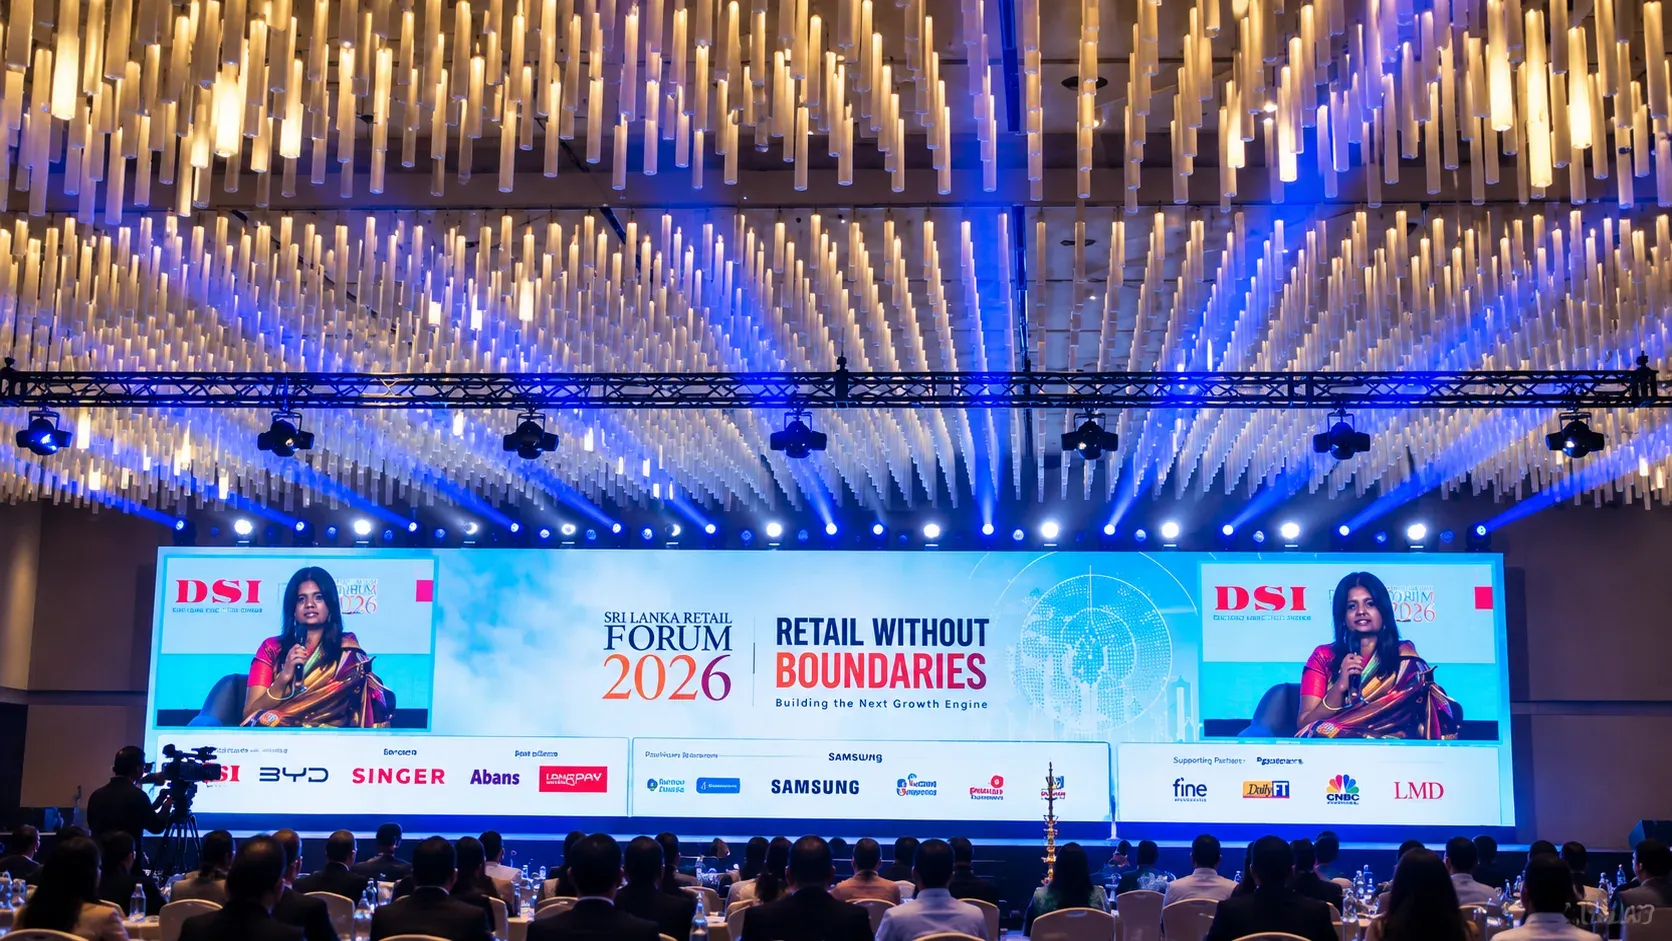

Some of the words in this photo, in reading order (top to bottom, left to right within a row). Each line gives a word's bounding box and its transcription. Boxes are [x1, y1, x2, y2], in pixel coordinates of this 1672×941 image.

[175, 579, 263, 604] DSI
[1214, 586, 1308, 611] DSI
[603, 611, 627, 624] SRI
[629, 611, 682, 624] LANKA
[683, 612, 733, 625] RETAIL
[603, 625, 733, 652] FORUM
[776, 617, 865, 647] RETAIL
[872, 617, 990, 648] WITHOUT
[602, 654, 732, 702] 2026
[776, 652, 987, 691] BOUNDARIES
[776, 698, 829, 711] Building
[833, 699, 854, 709] the
[859, 699, 888, 709] Next
[892, 699, 940, 710] Growth
[945, 700, 988, 712] Engine
[259, 767, 329, 783] BYD
[353, 768, 446, 784] SINGER
[470, 769, 521, 785] Abans
[771, 779, 860, 795] SAMSUNG
[1173, 777, 1208, 797] fine
[1273, 782, 1289, 796] FT
[1393, 781, 1445, 800] LMD
[1326, 793, 1360, 802] CNBC
